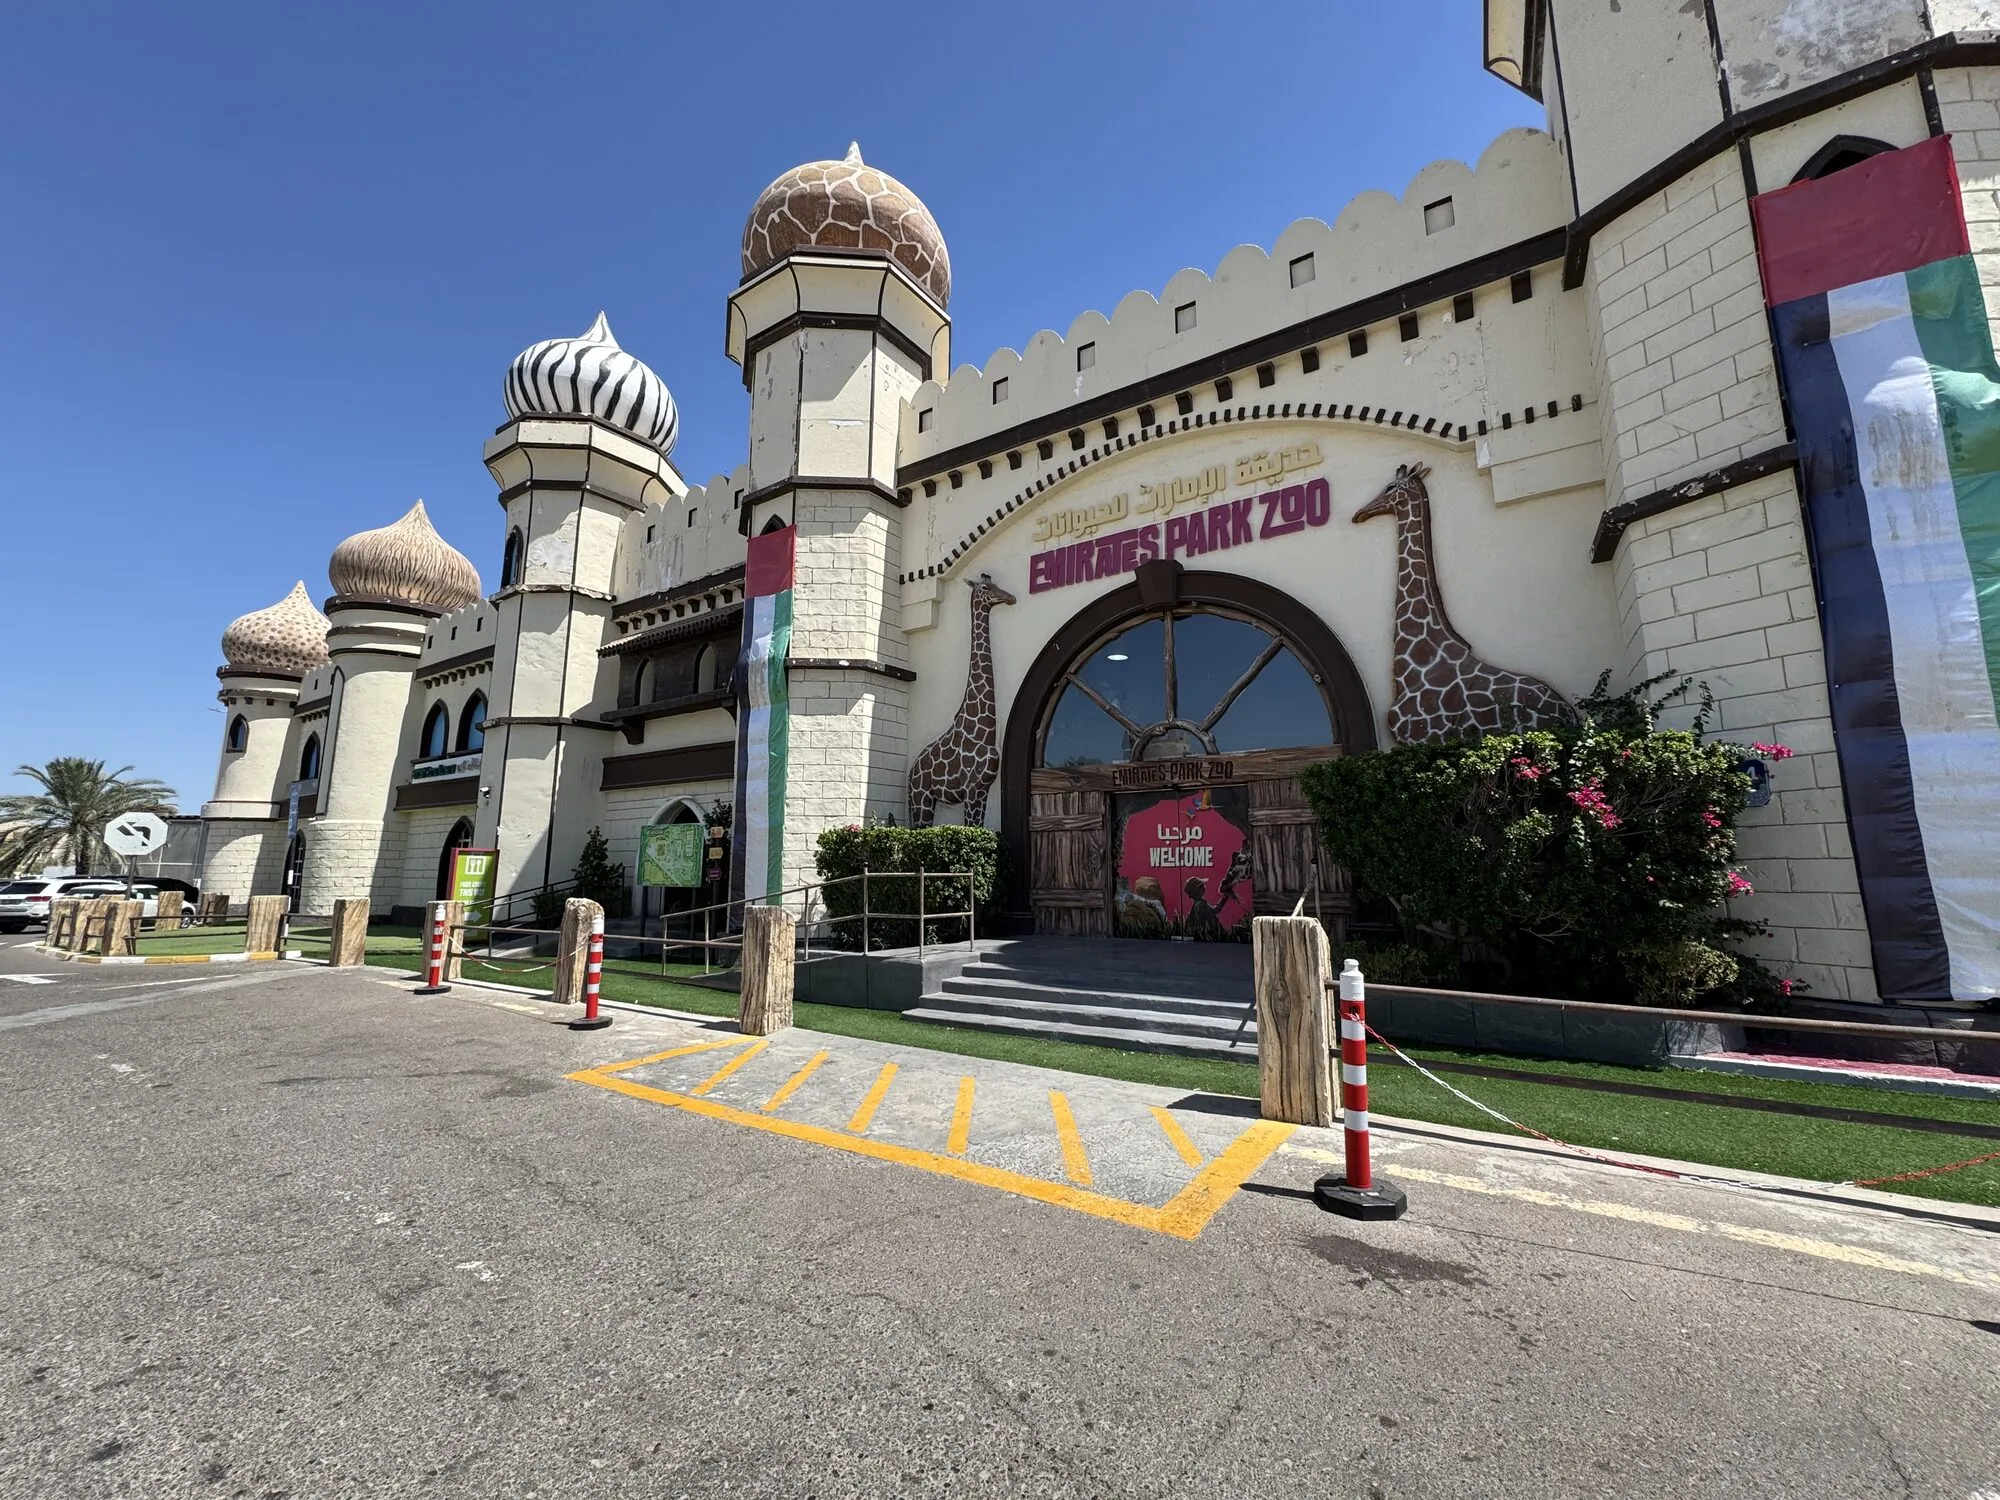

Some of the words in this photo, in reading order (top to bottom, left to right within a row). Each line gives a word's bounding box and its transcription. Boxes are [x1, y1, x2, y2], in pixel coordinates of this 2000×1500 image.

[1235, 442, 1325, 485] حديقة
[1136, 464, 1226, 516] الإمارات
[1029, 523, 1161, 595] EMIRATES
[1164, 498, 1253, 561] PARK
[1258, 477, 1331, 540] ZOO
[1032, 492, 1128, 542] للحيوانات
[1112, 765, 1166, 787] EMIRATES
[1170, 762, 1204, 781] PARK
[1208, 760, 1234, 780] ZOO
[1157, 823, 1203, 845] مرحبا
[1149, 846, 1214, 868] WELCOME
